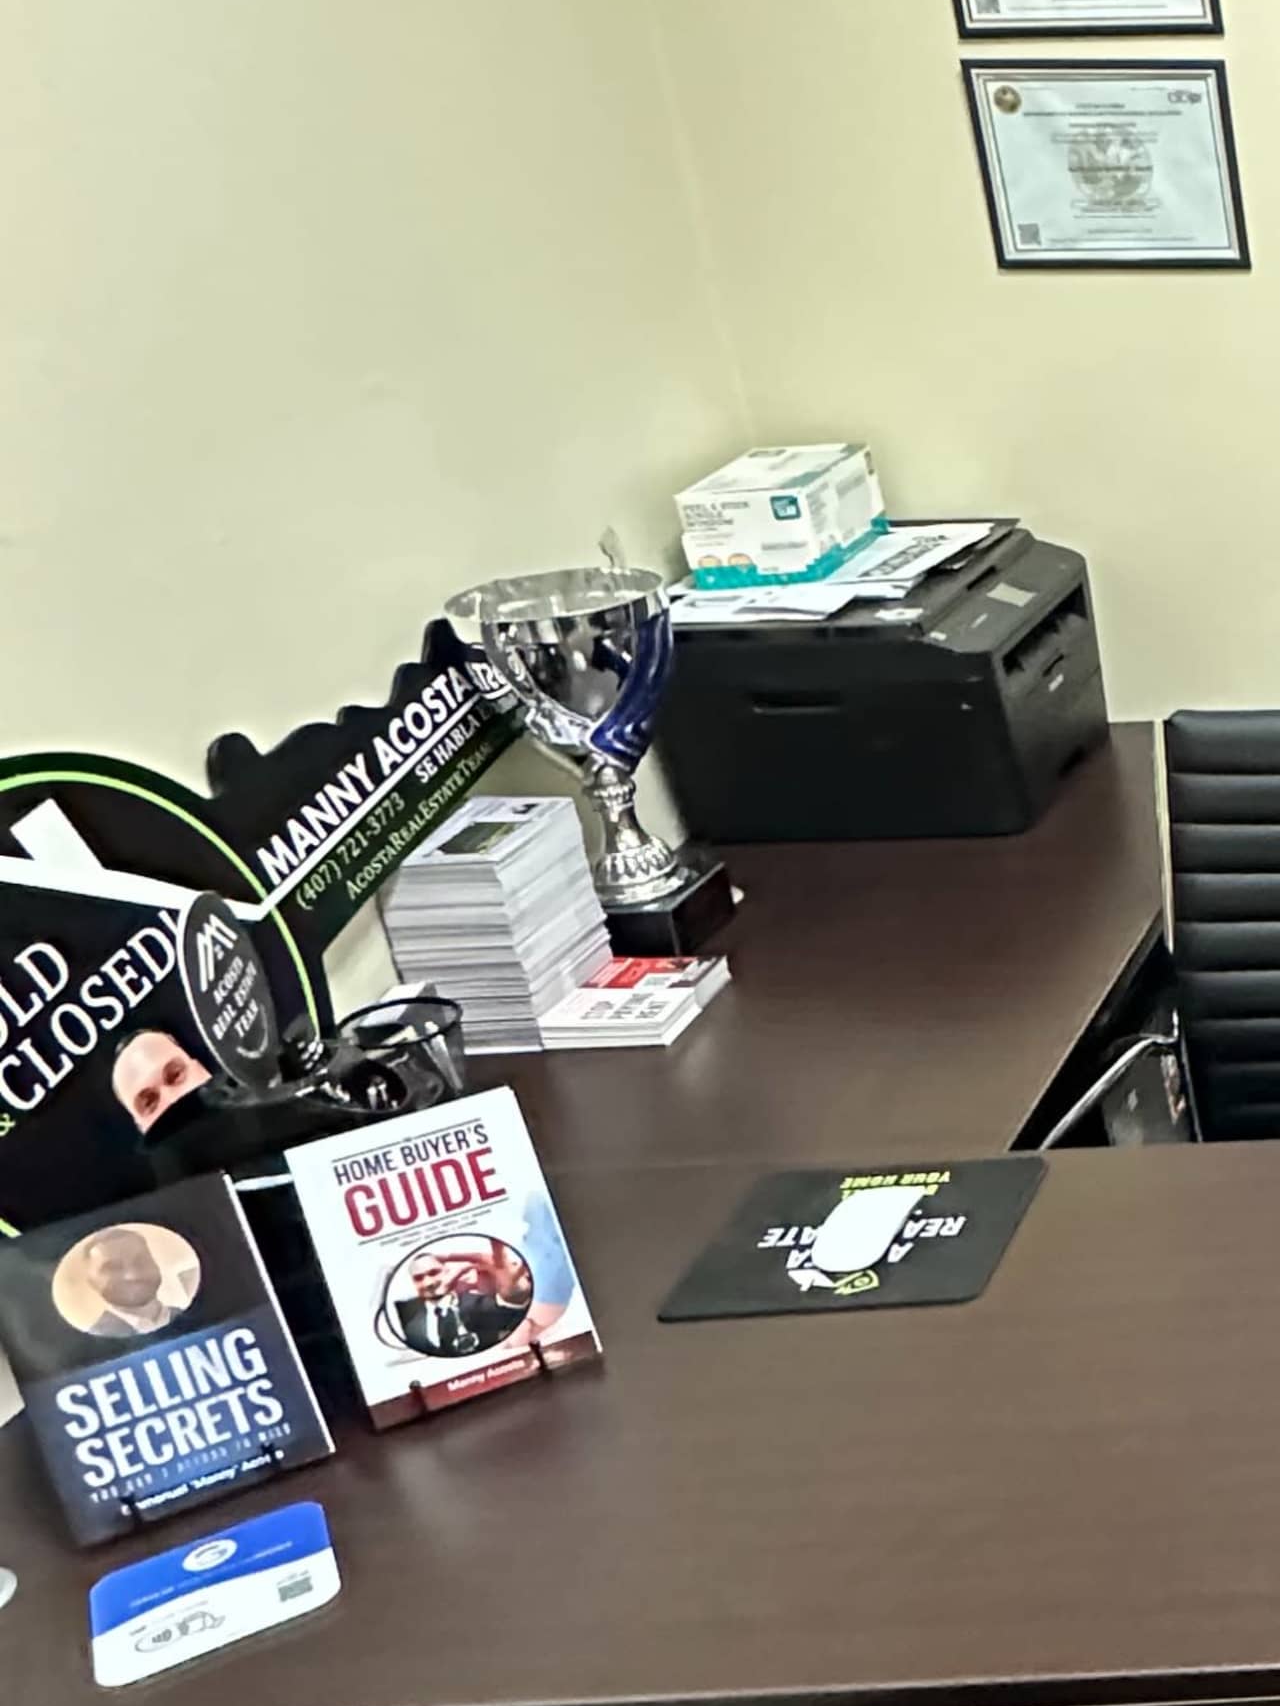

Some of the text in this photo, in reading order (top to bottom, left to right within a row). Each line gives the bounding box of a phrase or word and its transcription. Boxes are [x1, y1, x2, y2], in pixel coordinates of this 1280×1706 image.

[256, 666, 474, 886] MANNY ACOSTA
[415, 713, 481, 784] SE HABLA
[295, 791, 406, 911] (407) 721-3773
[333, 1123, 490, 1186] HOME BUYER'S
[343, 1146, 507, 1238] GUIDE
[902, 1215, 967, 1239] REA
[55, 1328, 268, 1439] SELLING
[75, 1379, 284, 1488] SECRETS
